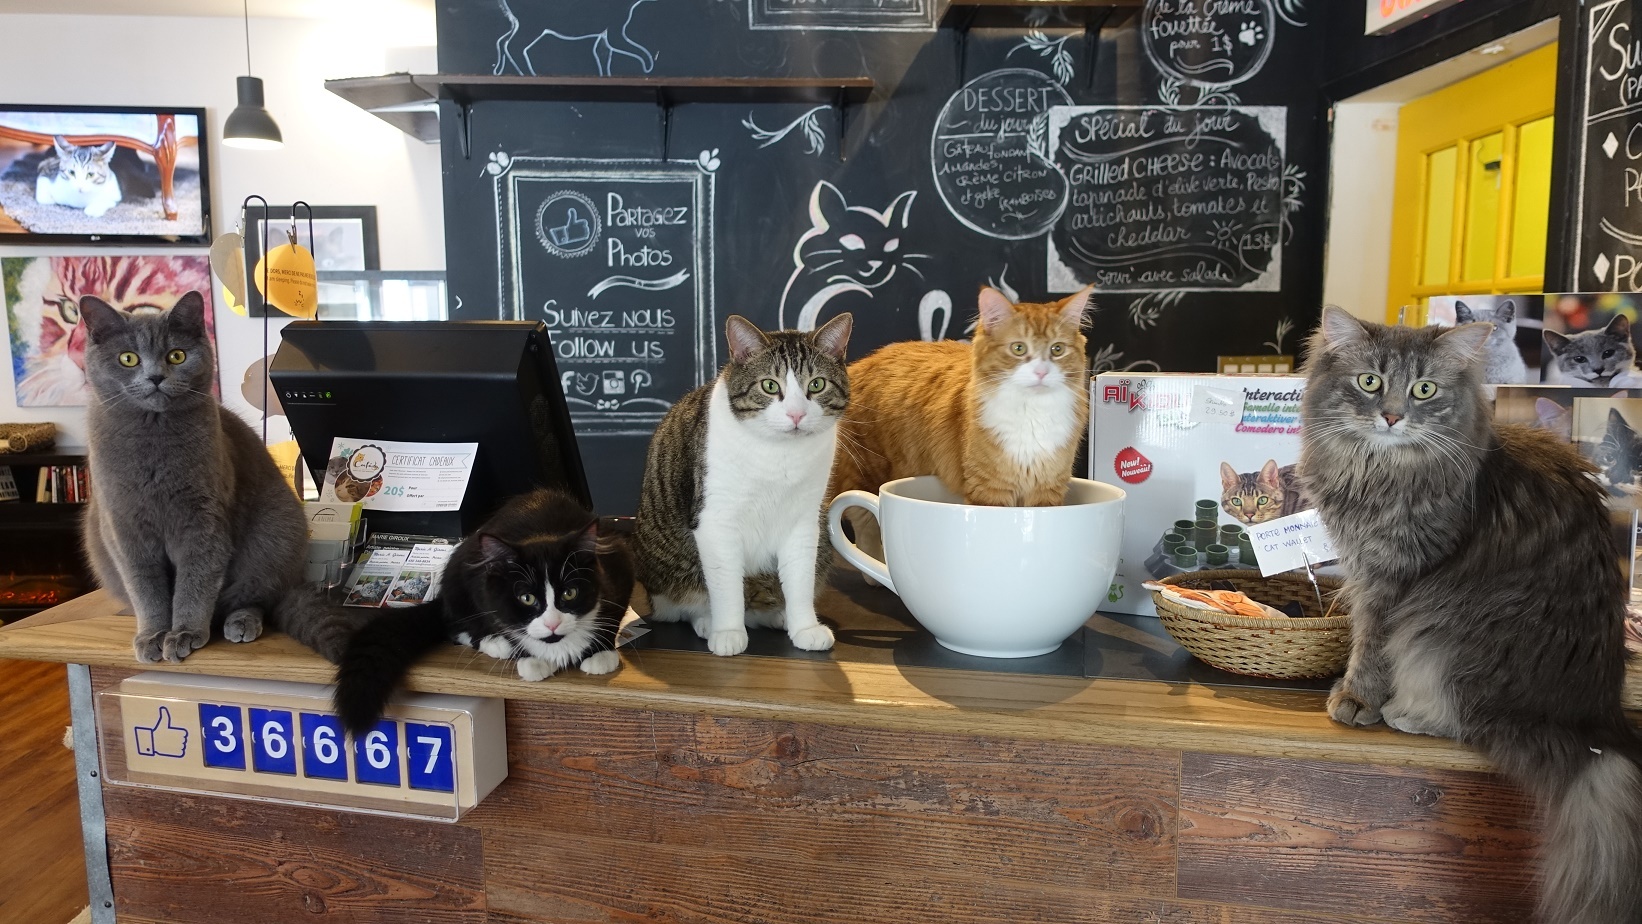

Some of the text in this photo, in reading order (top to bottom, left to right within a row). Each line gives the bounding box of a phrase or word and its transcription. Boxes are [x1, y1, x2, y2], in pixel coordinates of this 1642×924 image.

[1170, 33, 1234, 59] pour 1$
[963, 86, 1054, 113] DESSERT
[973, 113, 998, 133] du
[1163, 115, 1187, 134] du
[1184, 111, 1241, 150] jour
[1172, 195, 1247, 217] tomates
[607, 237, 673, 267] Photos
[542, 299, 616, 328] Suivez
[631, 340, 665, 359] us
[1235, 422, 1285, 434] Comedero
[1120, 457, 1140, 470] New!
[383, 485, 405, 498] 20$
[1264, 543, 1280, 552] CAT
